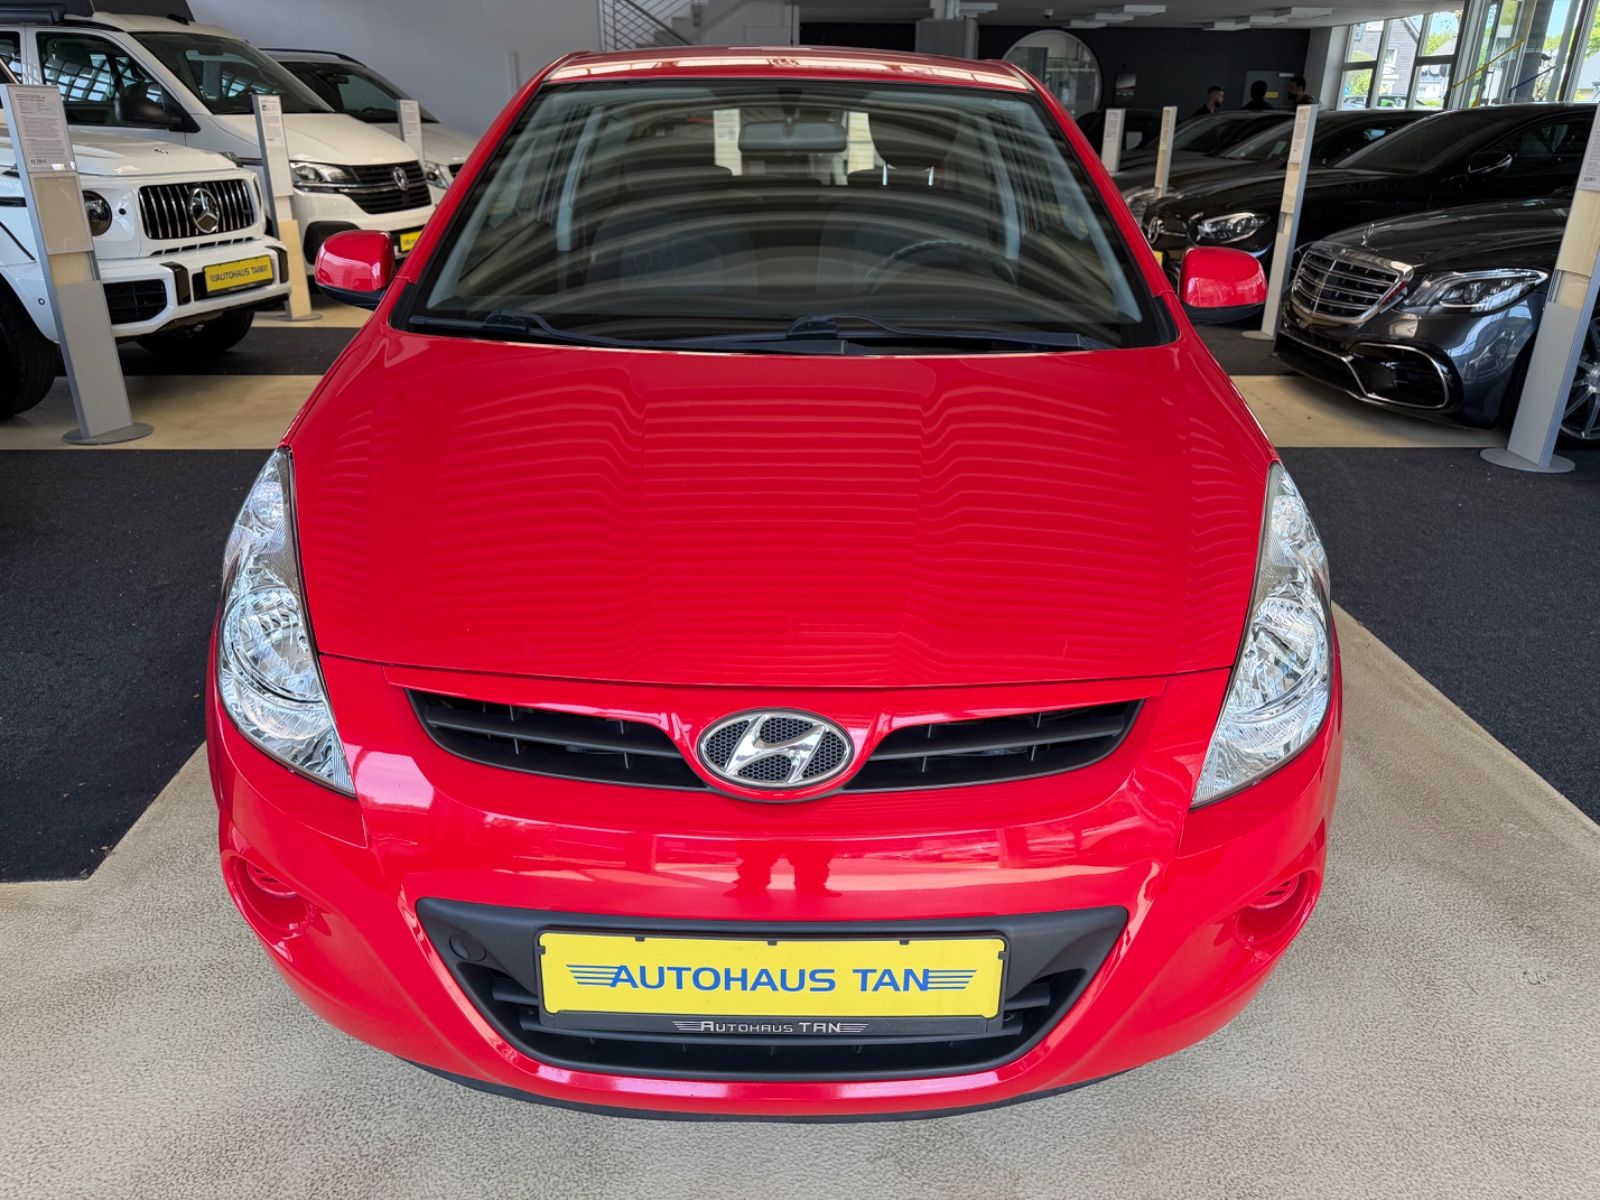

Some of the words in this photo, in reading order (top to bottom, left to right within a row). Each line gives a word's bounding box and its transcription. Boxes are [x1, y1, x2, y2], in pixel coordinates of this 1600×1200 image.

[214, 268, 250, 281] AUTOHAUS
[609, 964, 836, 992] AUTOHAUS
[852, 968, 930, 992] TAN
[799, 1022, 841, 1033] TAN
